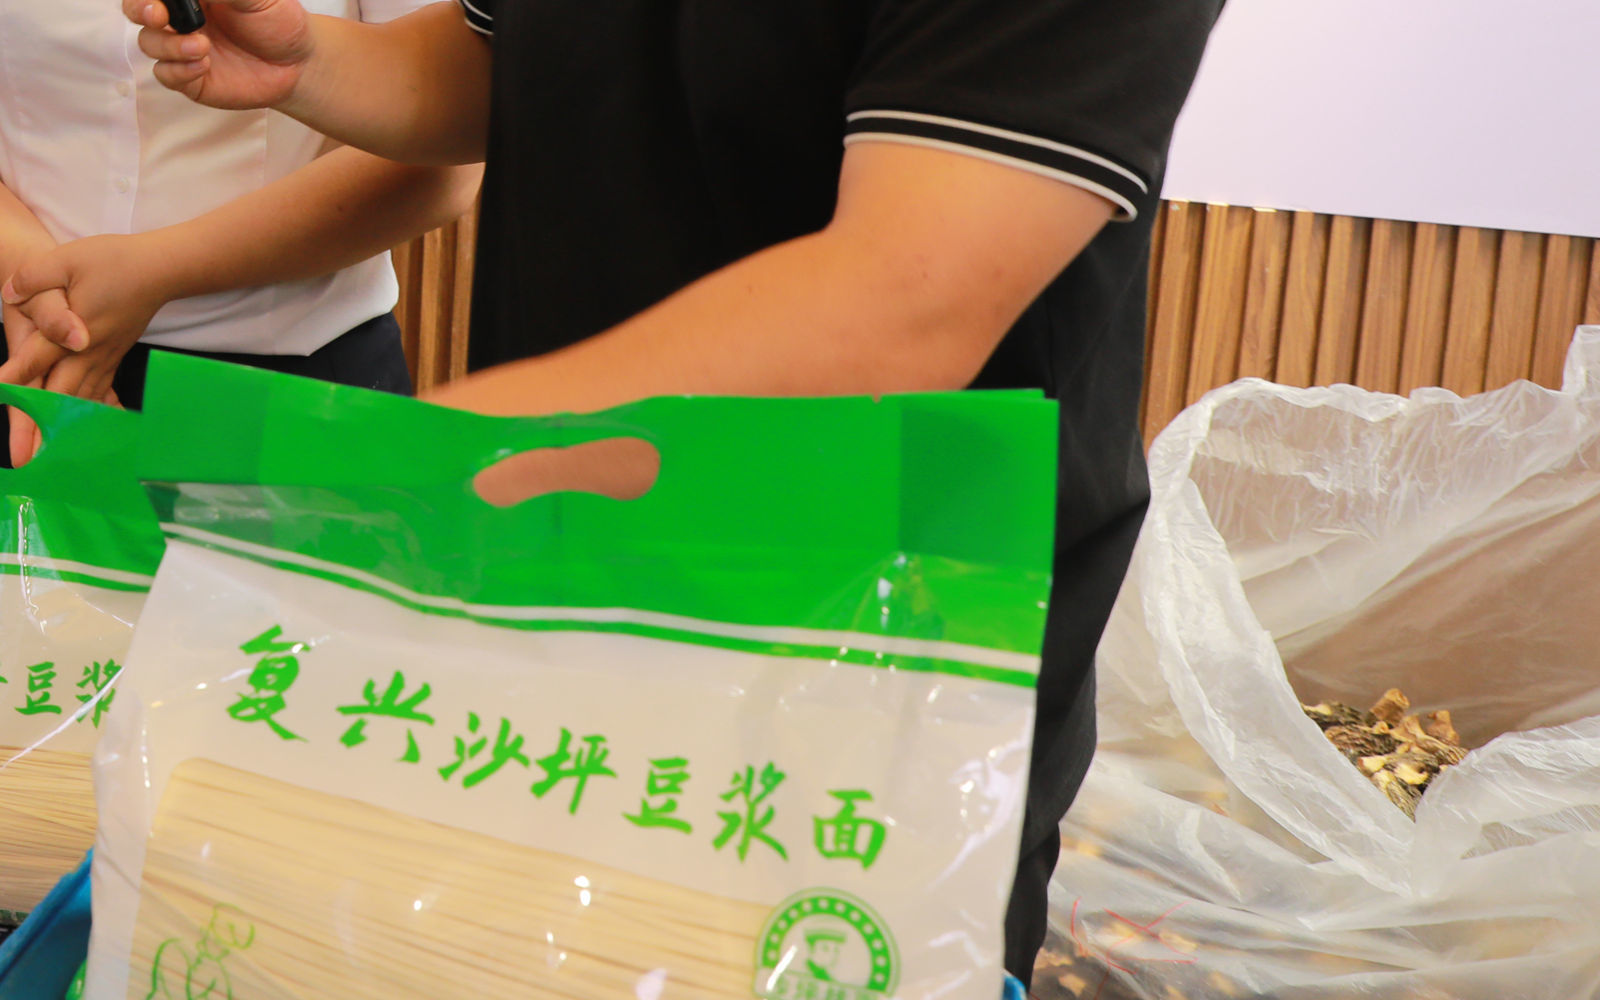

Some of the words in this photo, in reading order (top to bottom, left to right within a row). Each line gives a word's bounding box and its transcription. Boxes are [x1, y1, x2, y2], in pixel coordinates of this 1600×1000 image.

[227, 624, 888, 871] 复兴沙坪豆浆面
